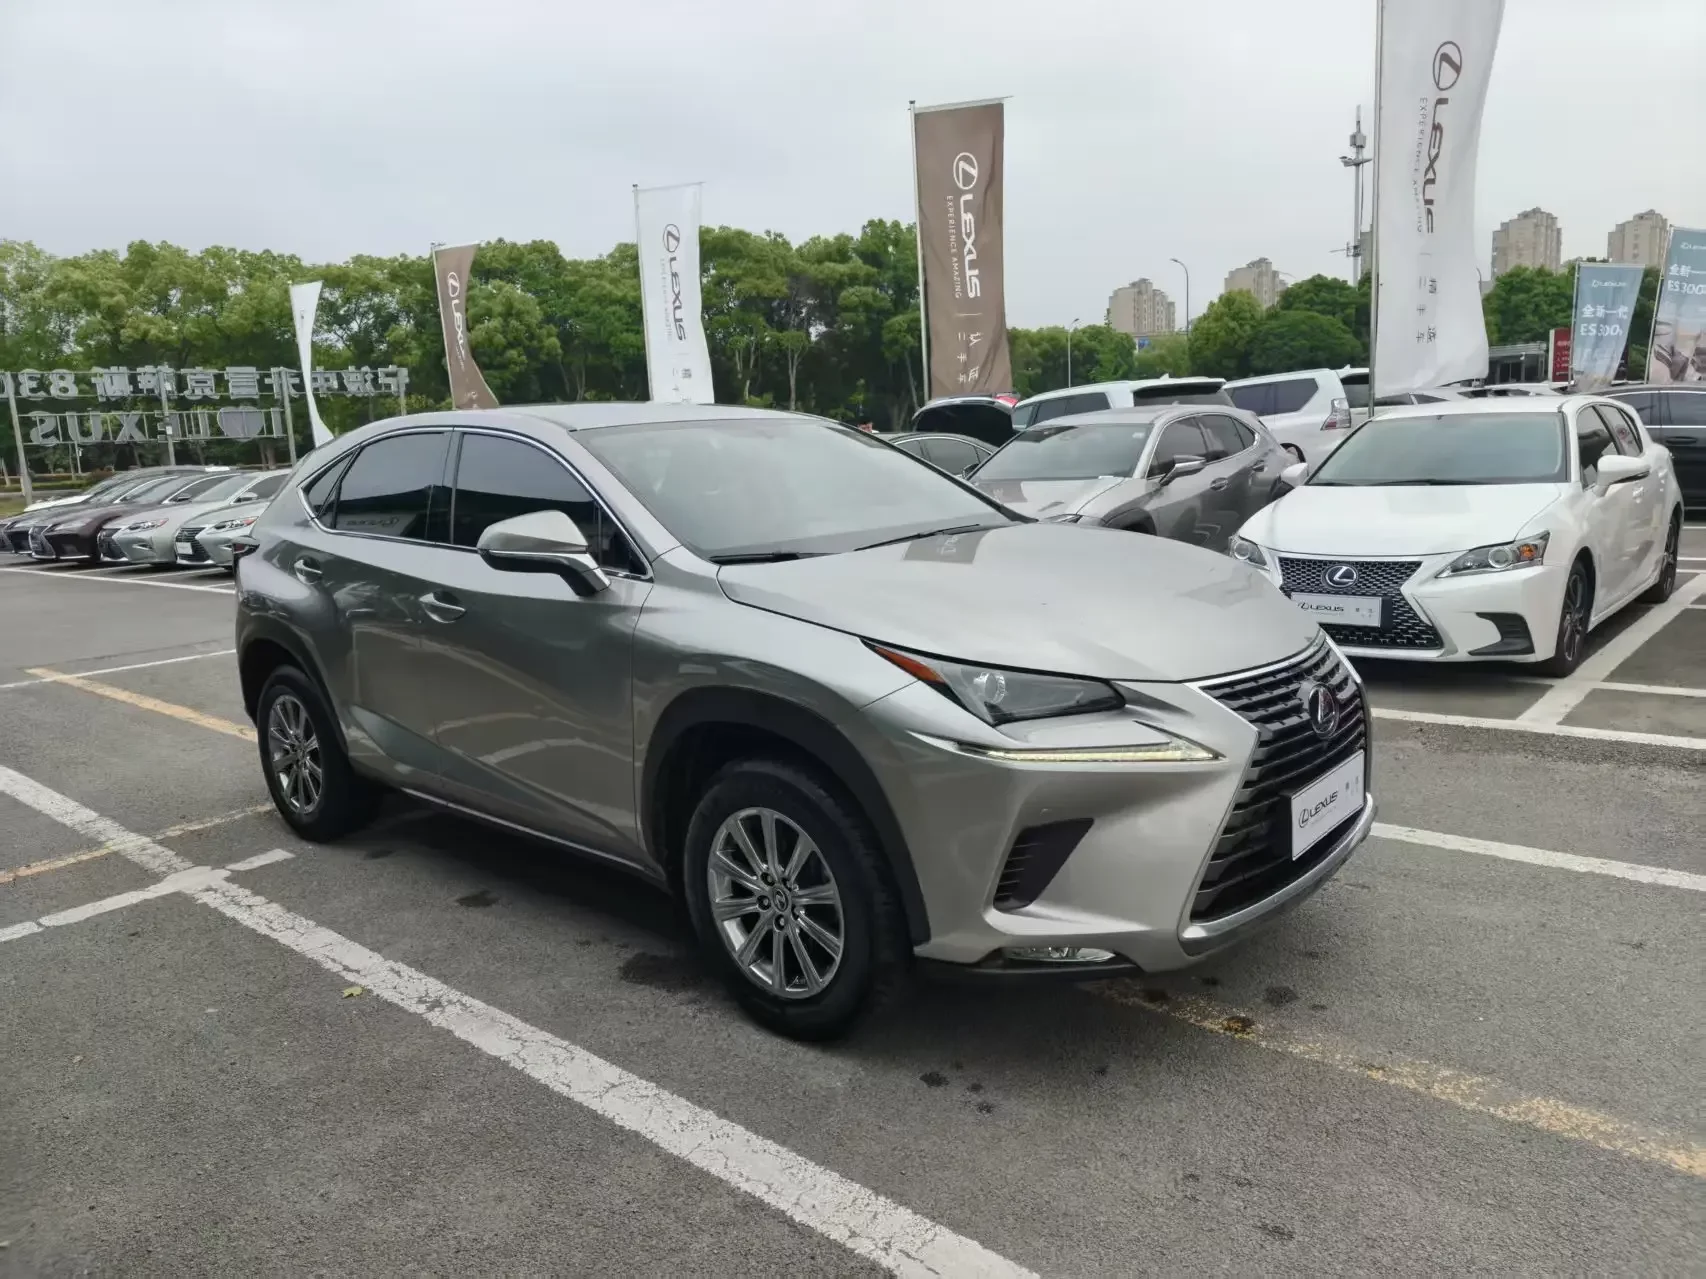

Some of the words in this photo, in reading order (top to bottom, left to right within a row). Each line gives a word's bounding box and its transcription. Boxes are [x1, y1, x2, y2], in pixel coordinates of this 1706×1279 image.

[946, 195, 958, 255] EXPERIENCE
[959, 193, 981, 298] LEXUS
[669, 256, 686, 341] LEXUS
[951, 256, 963, 299] AMAZING
[1581, 303, 1629, 320] 全新一代
[957, 331, 967, 384] 二手车
[968, 331, 982, 382] 认证
[1309, 790, 1338, 818] LEXUS
